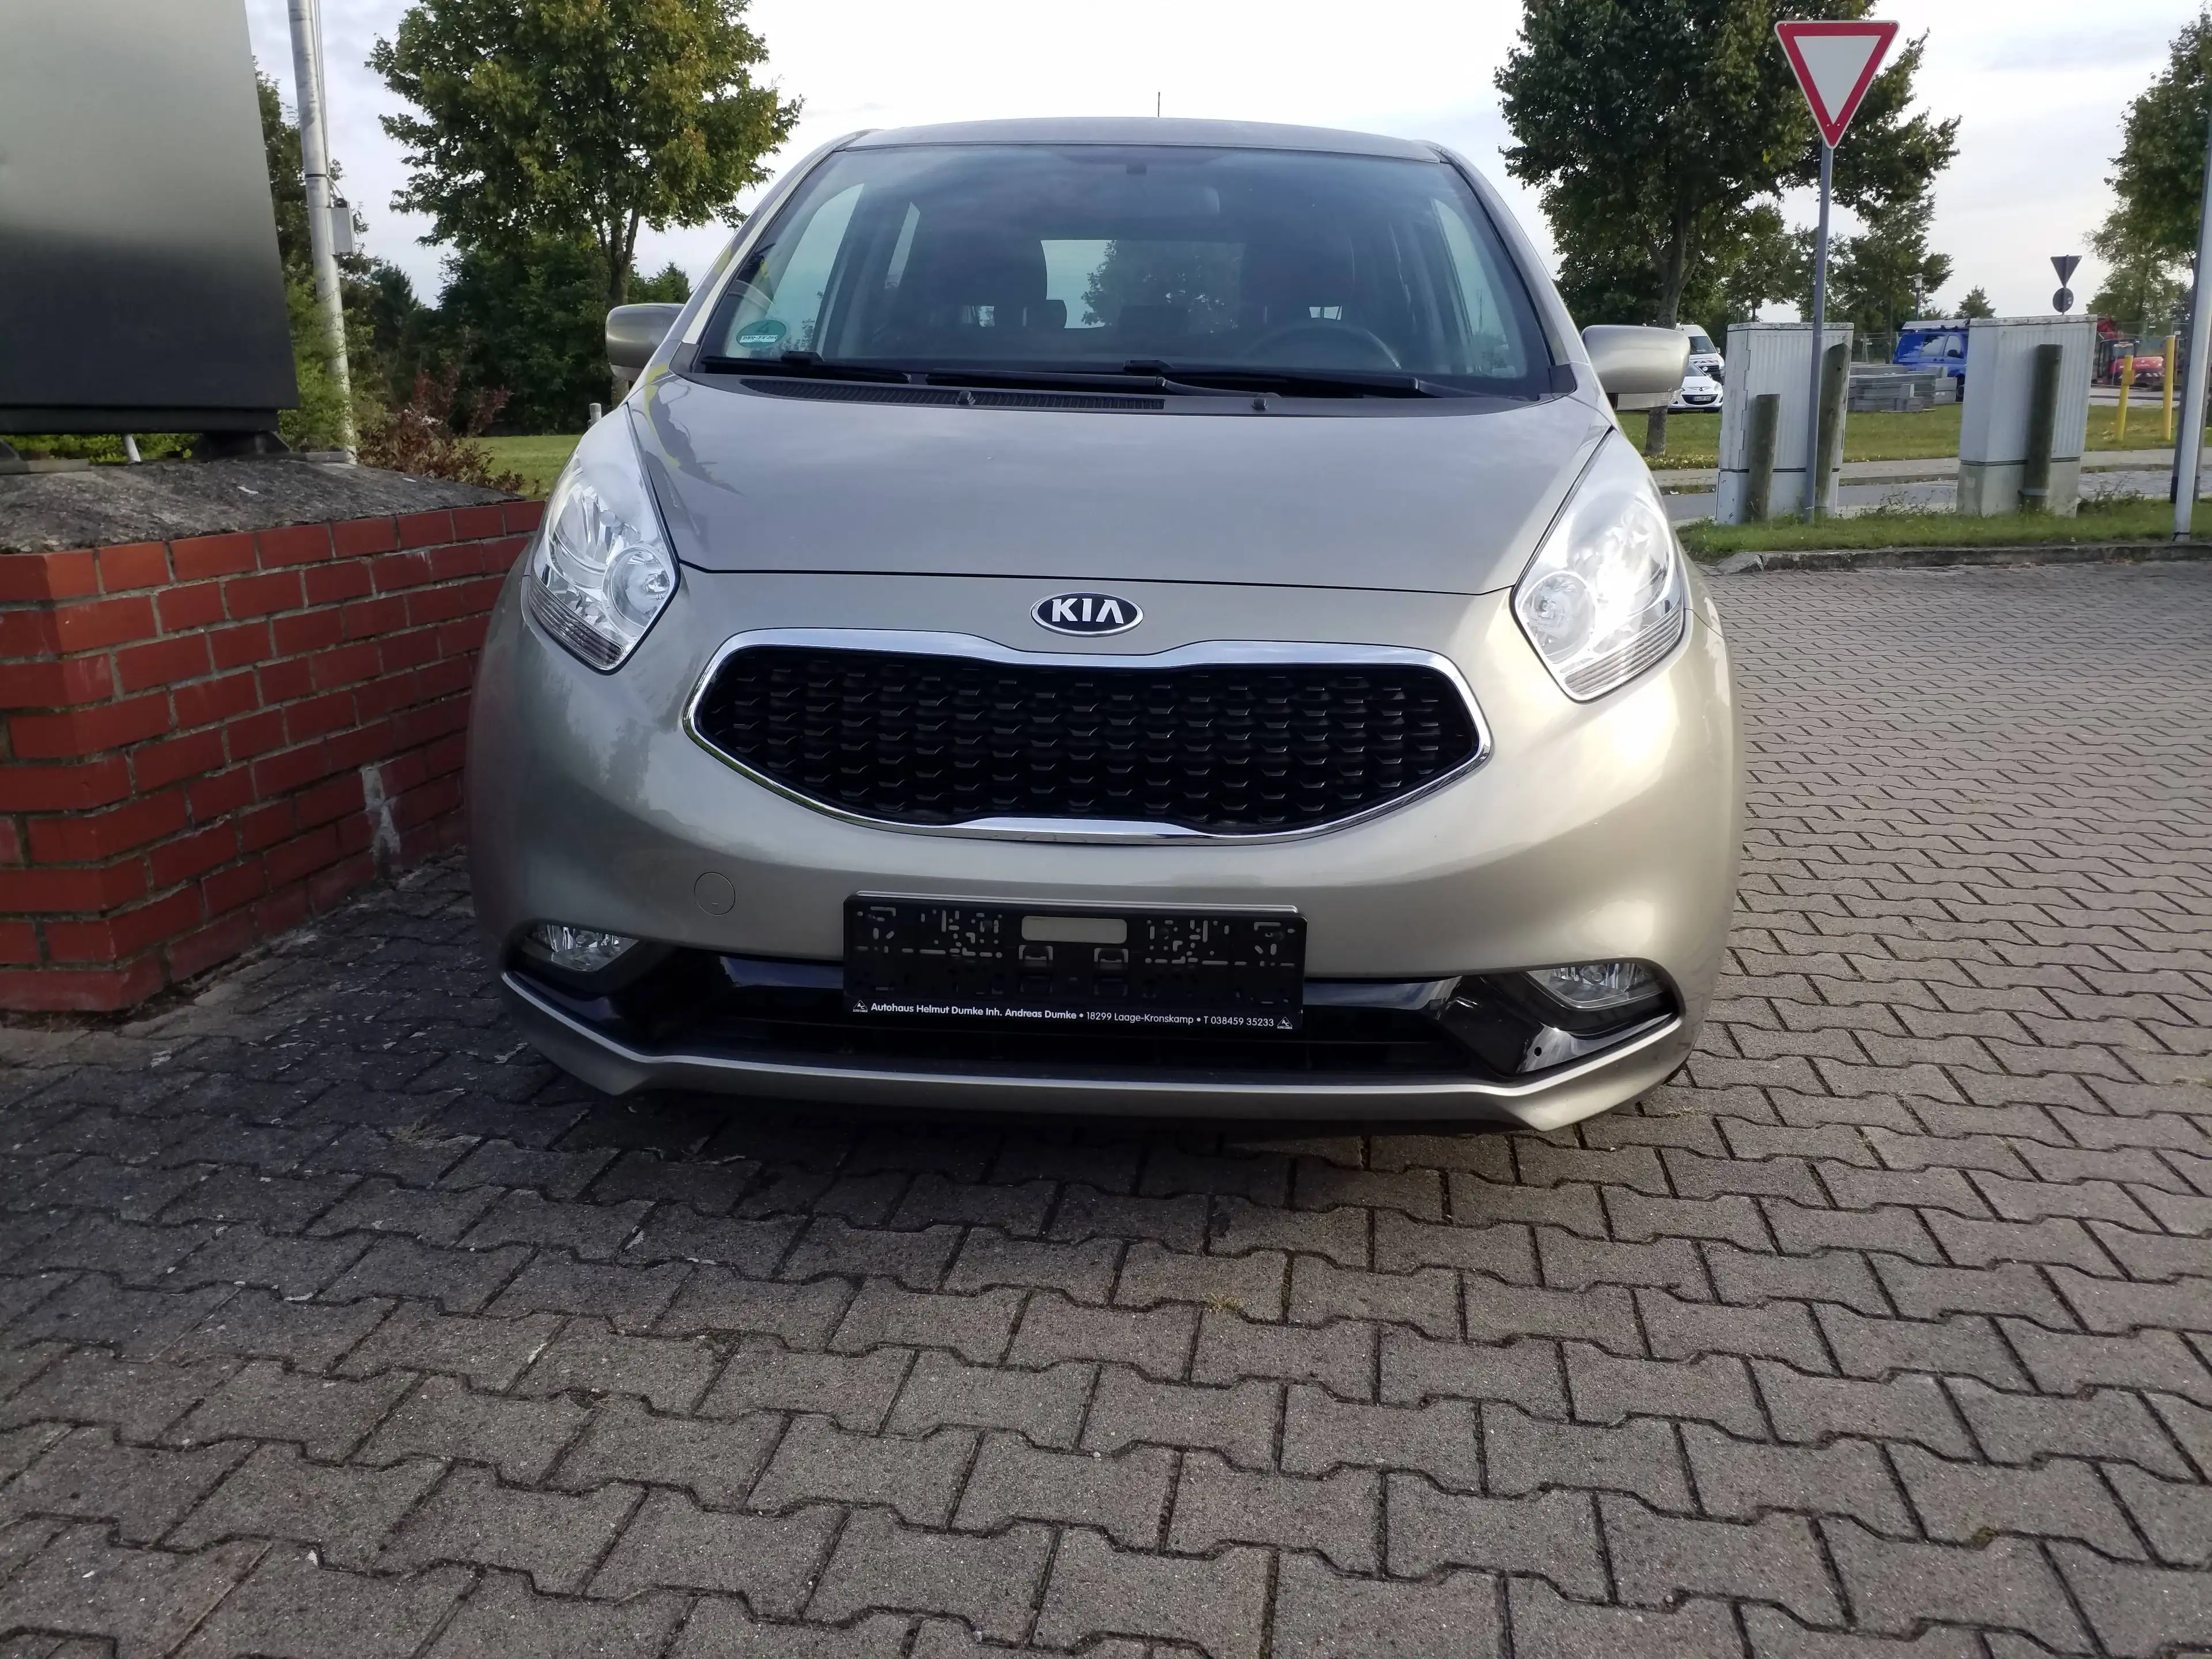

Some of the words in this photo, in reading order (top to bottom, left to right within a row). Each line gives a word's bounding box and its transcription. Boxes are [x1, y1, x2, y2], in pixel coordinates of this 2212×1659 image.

[1052, 598, 1124, 624] KIA
[871, 1003, 914, 1012] Autohaus
[916, 1005, 949, 1013] Helmut
[952, 1006, 983, 1015] Dumke
[986, 1007, 1002, 1016] Inh.
[1005, 1009, 1042, 1017] Andreas
[1045, 1010, 1077, 1018] Dumke
[1086, 1012, 1111, 1020] 18299
[1115, 1013, 1194, 1025] Laage-Kronskamp
[1211, 1017, 1244, 1025] 038459
[1247, 1018, 1274, 1026] 35233
